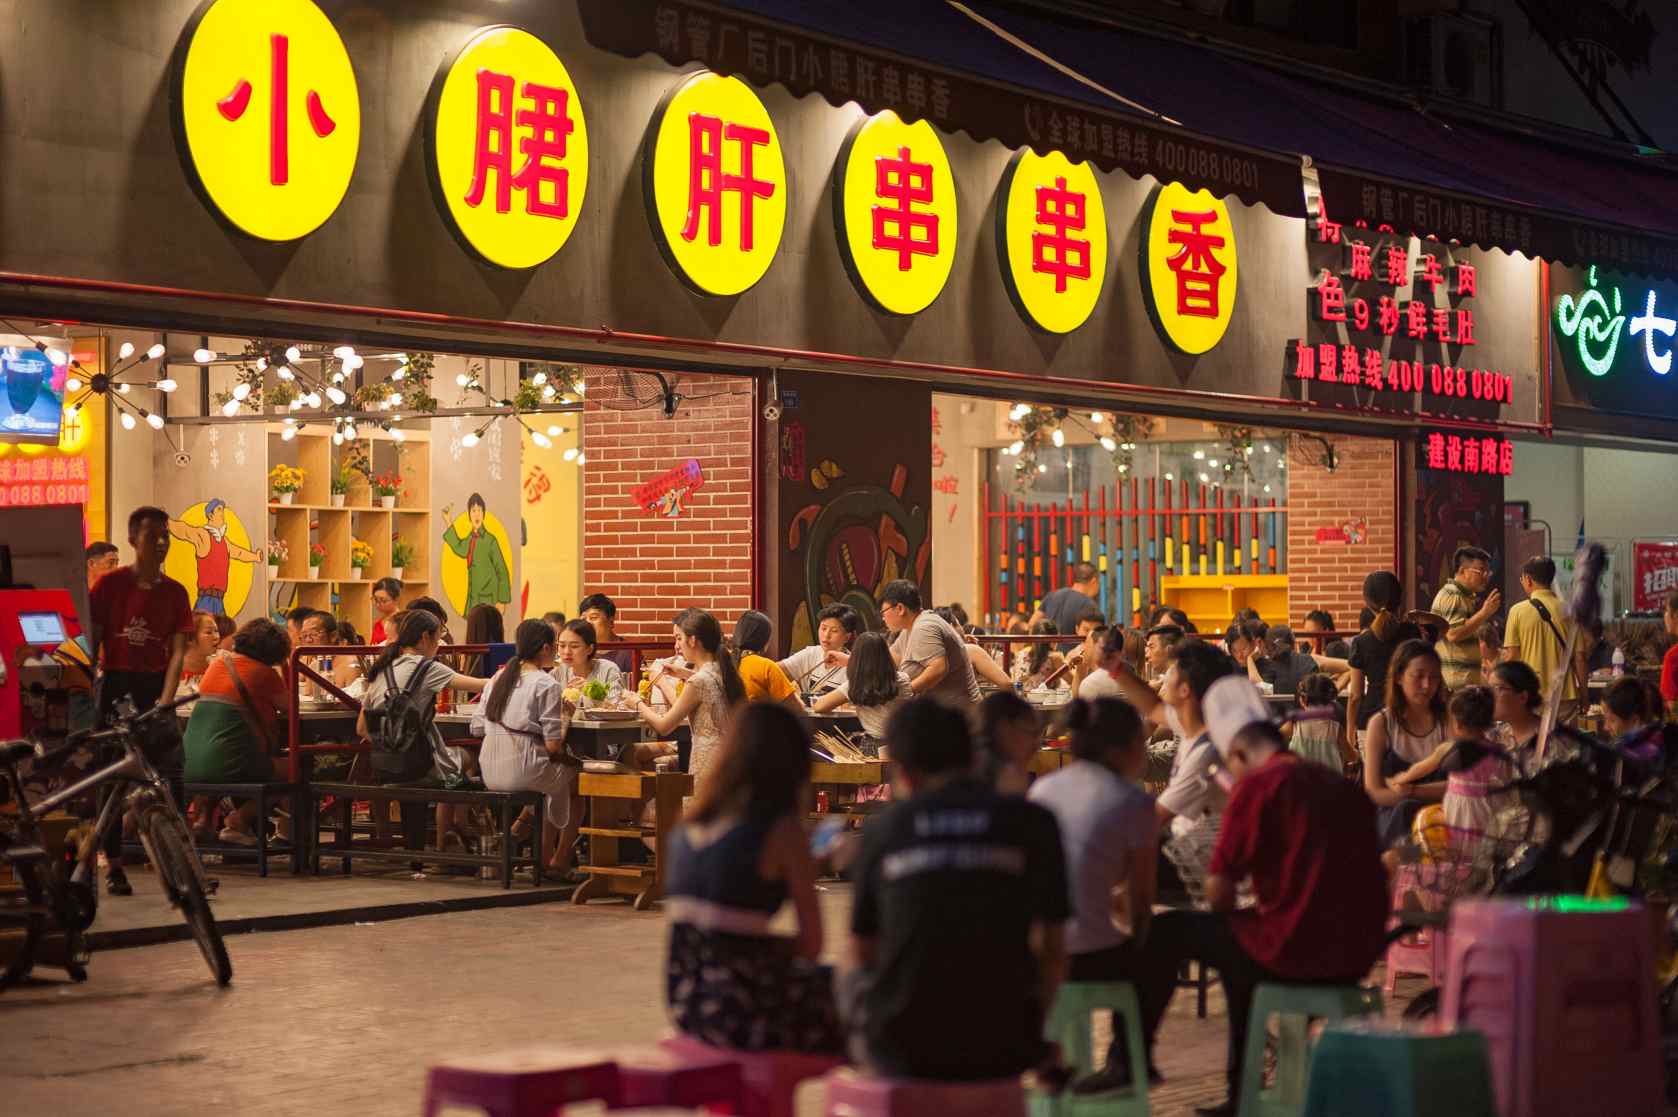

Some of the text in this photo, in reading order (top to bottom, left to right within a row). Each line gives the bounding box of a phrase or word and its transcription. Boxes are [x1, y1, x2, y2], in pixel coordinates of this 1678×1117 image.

[1351, 239, 1477, 298] 麻辣牛肉
[1296, 339, 1513, 405] 加盟热线 400 088 0801
[1427, 432, 1513, 476] 建设南路店
